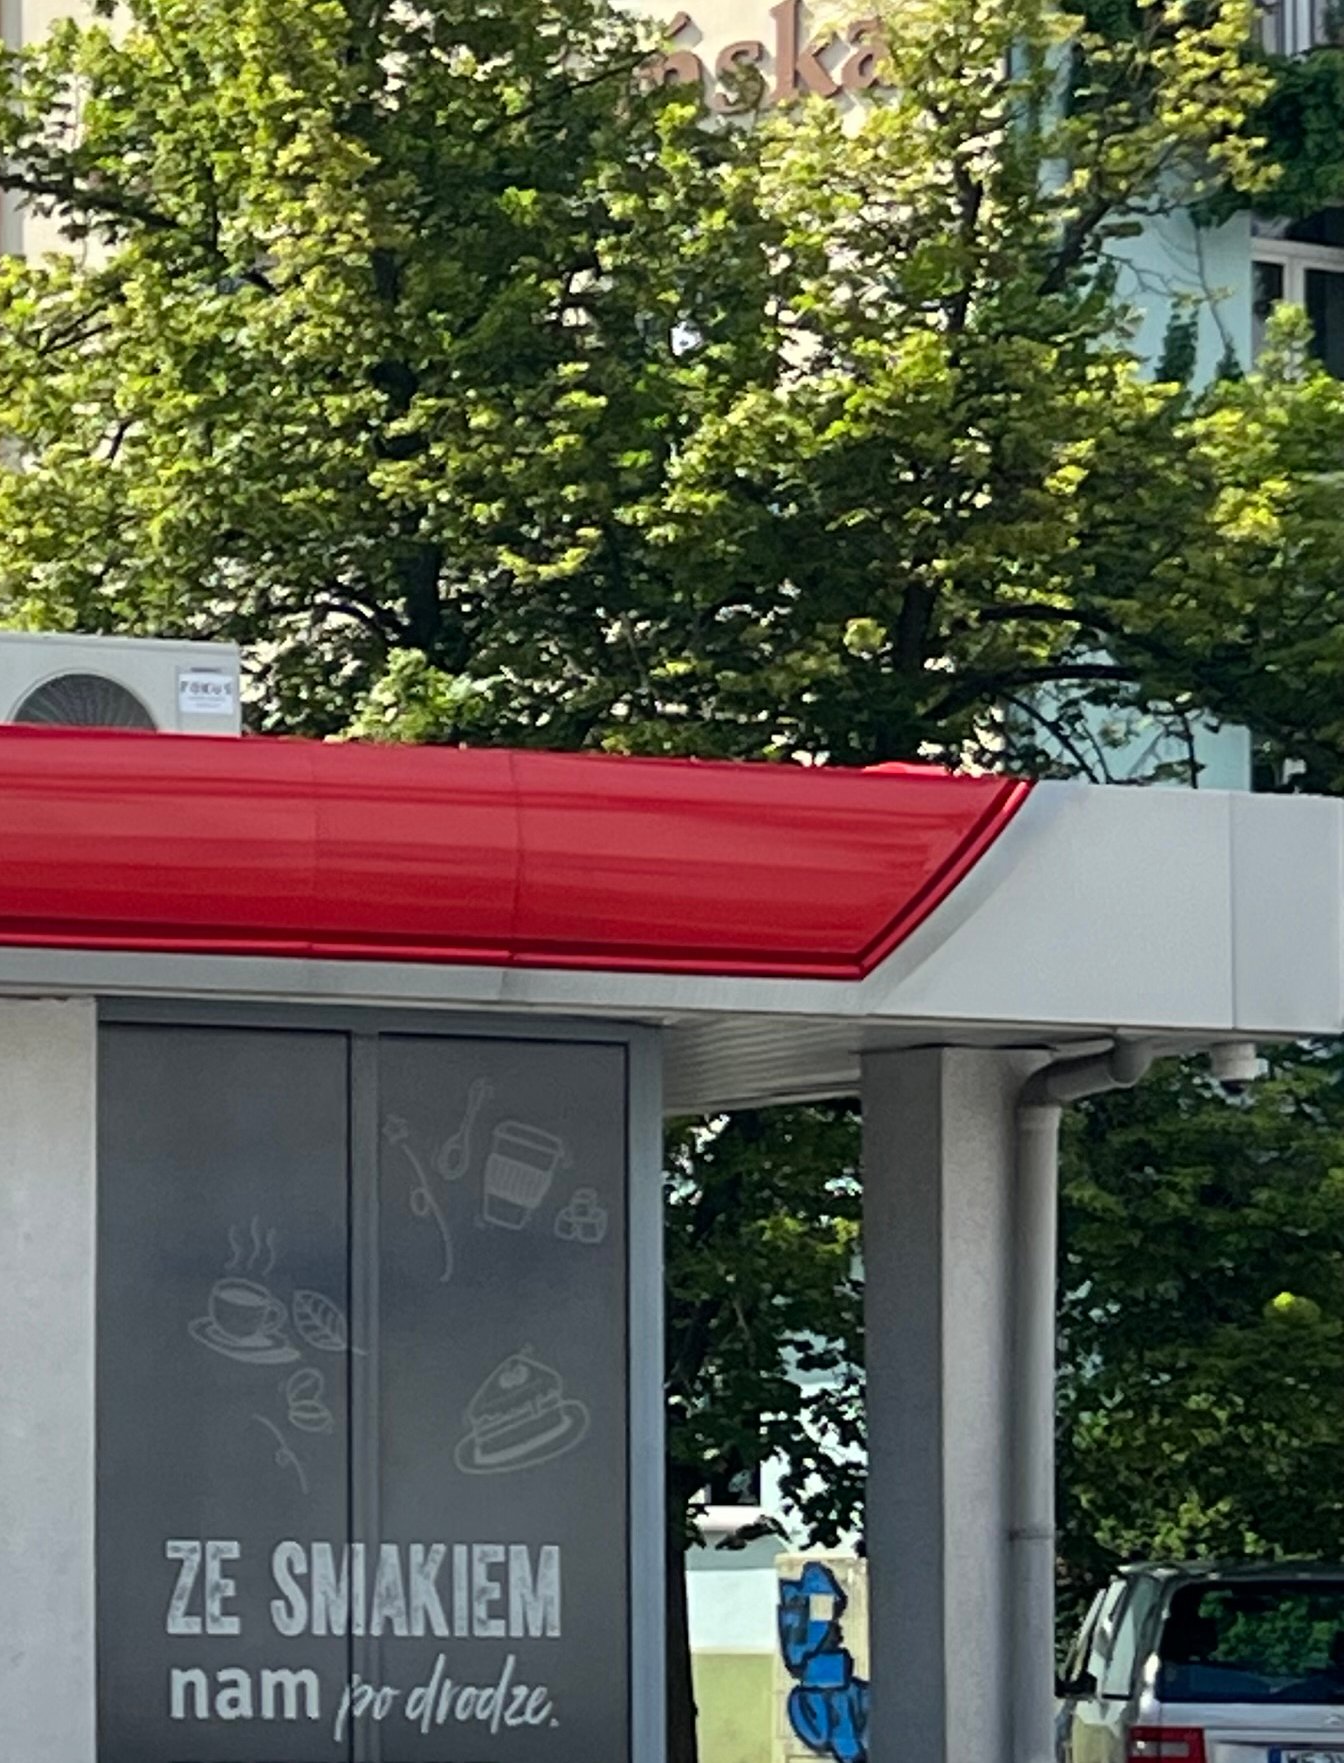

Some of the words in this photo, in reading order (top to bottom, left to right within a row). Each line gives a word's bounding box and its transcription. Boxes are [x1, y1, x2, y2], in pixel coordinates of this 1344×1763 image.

[165, 1540, 241, 1636] ZE
[270, 1540, 562, 1639] SMAKIEM
[169, 1666, 321, 1721] nam
[332, 1673, 401, 1743] po
[404, 1653, 561, 1735] drodze.
